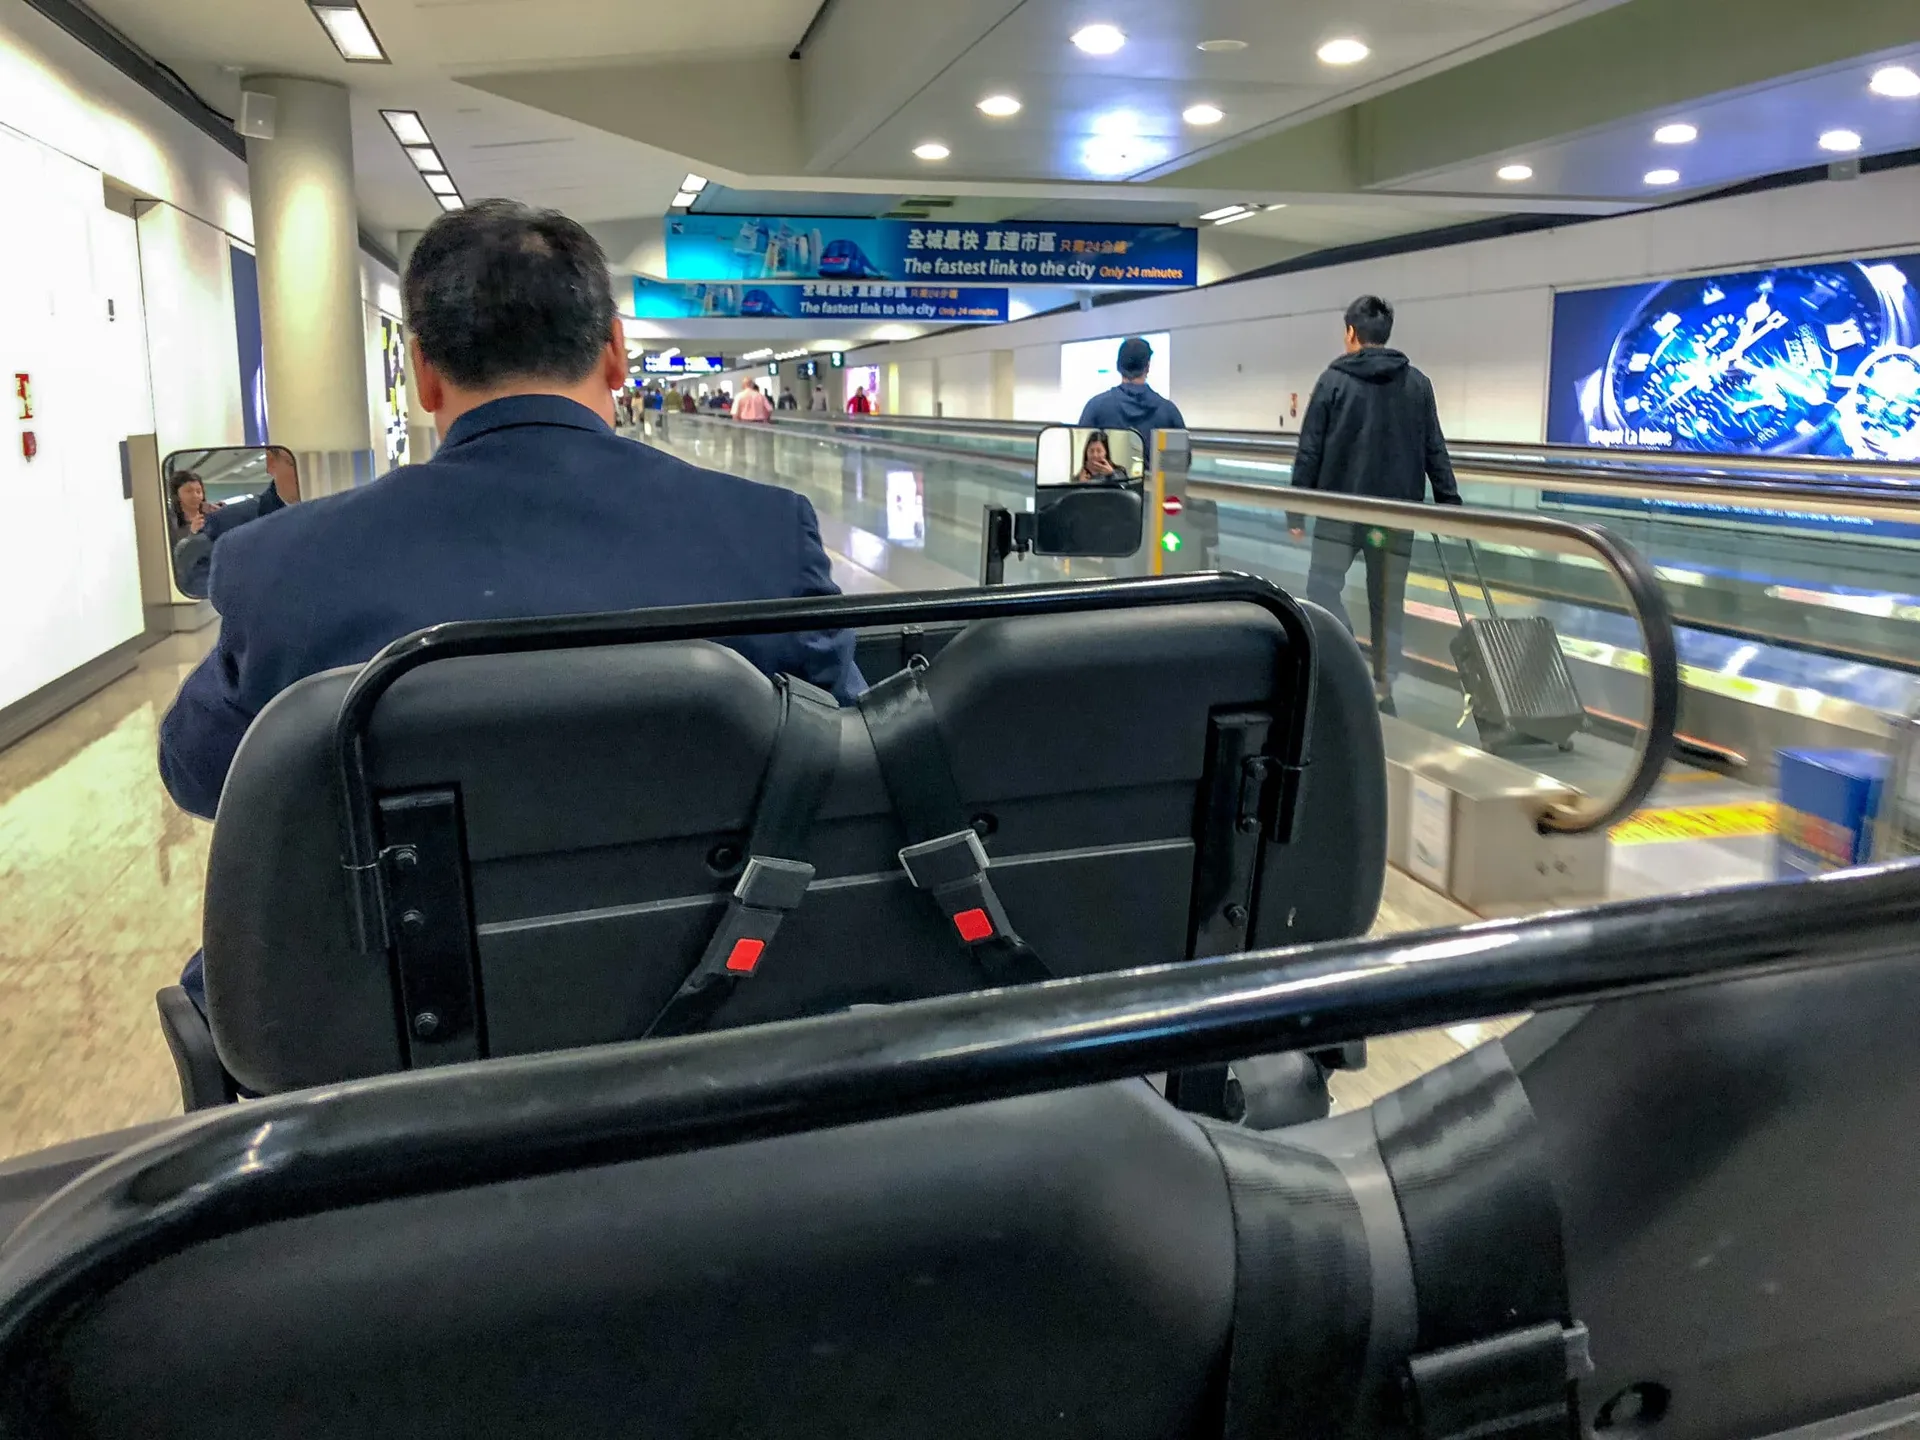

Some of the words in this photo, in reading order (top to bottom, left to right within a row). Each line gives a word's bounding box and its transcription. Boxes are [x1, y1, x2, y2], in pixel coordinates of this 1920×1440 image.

[907, 229, 980, 250] 全城最快
[984, 231, 1057, 252] 直達市區
[904, 258, 932, 274] The
[934, 258, 987, 275] fastest
[989, 258, 1018, 275] link
[1021, 260, 1037, 276] to
[1040, 259, 1065, 276] the
[1068, 261, 1096, 280] city
[1100, 266, 1124, 280] Only
[1126, 266, 1139, 278] 24
[1141, 267, 1183, 279] minutes
[800, 302, 820, 314] The
[822, 302, 858, 314] fastest
[860, 302, 880, 314] link
[883, 304, 894, 314] to
[896, 303, 914, 315] the
[916, 303, 936, 318] city
